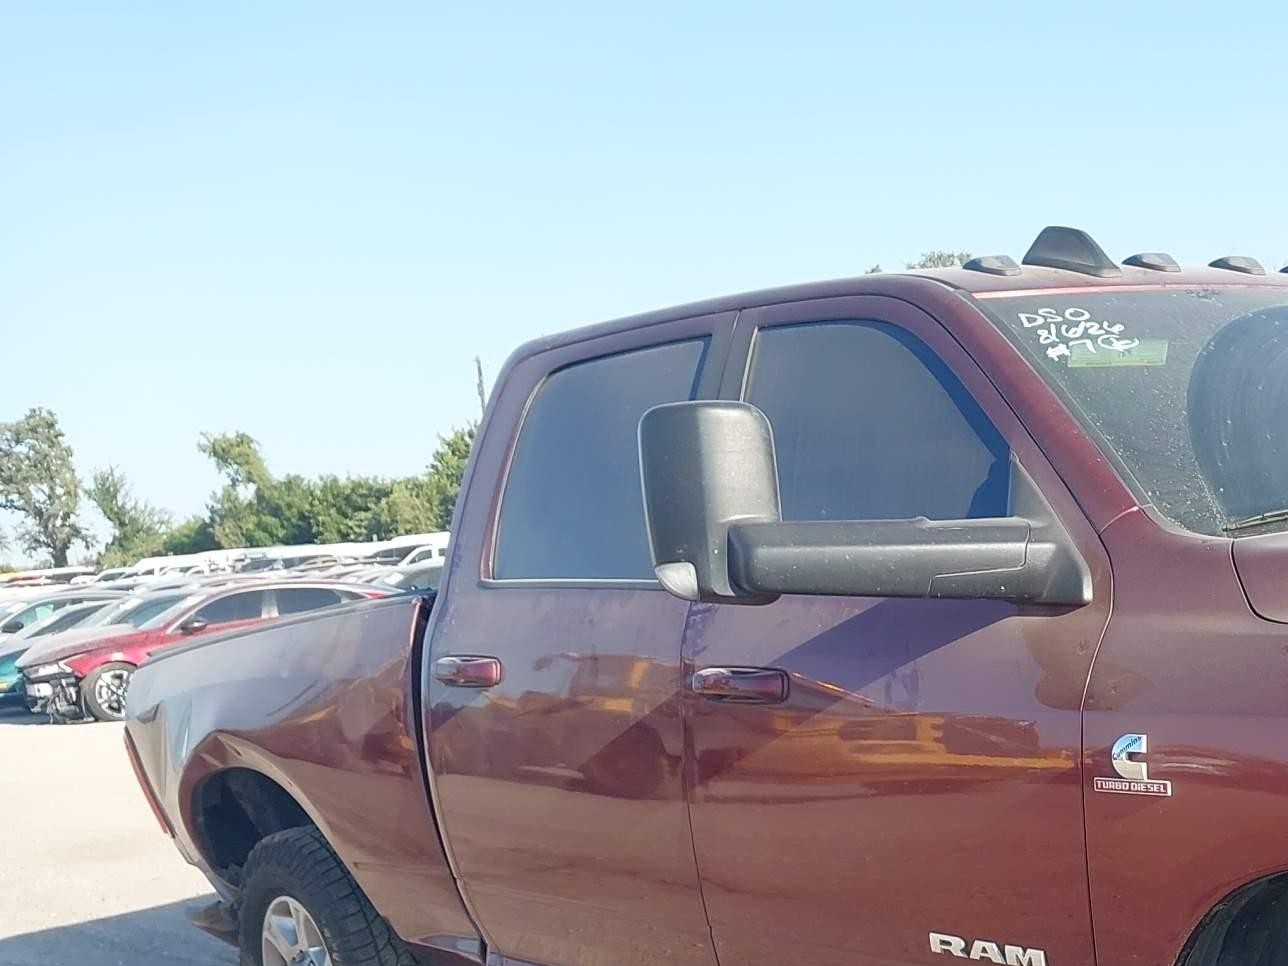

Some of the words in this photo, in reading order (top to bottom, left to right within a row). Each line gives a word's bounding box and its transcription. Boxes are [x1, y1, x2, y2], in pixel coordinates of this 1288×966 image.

[1018, 308, 1091, 328] DSO
[1096, 780, 1130, 790] TURBO
[1130, 781, 1167, 793] DIESEL
